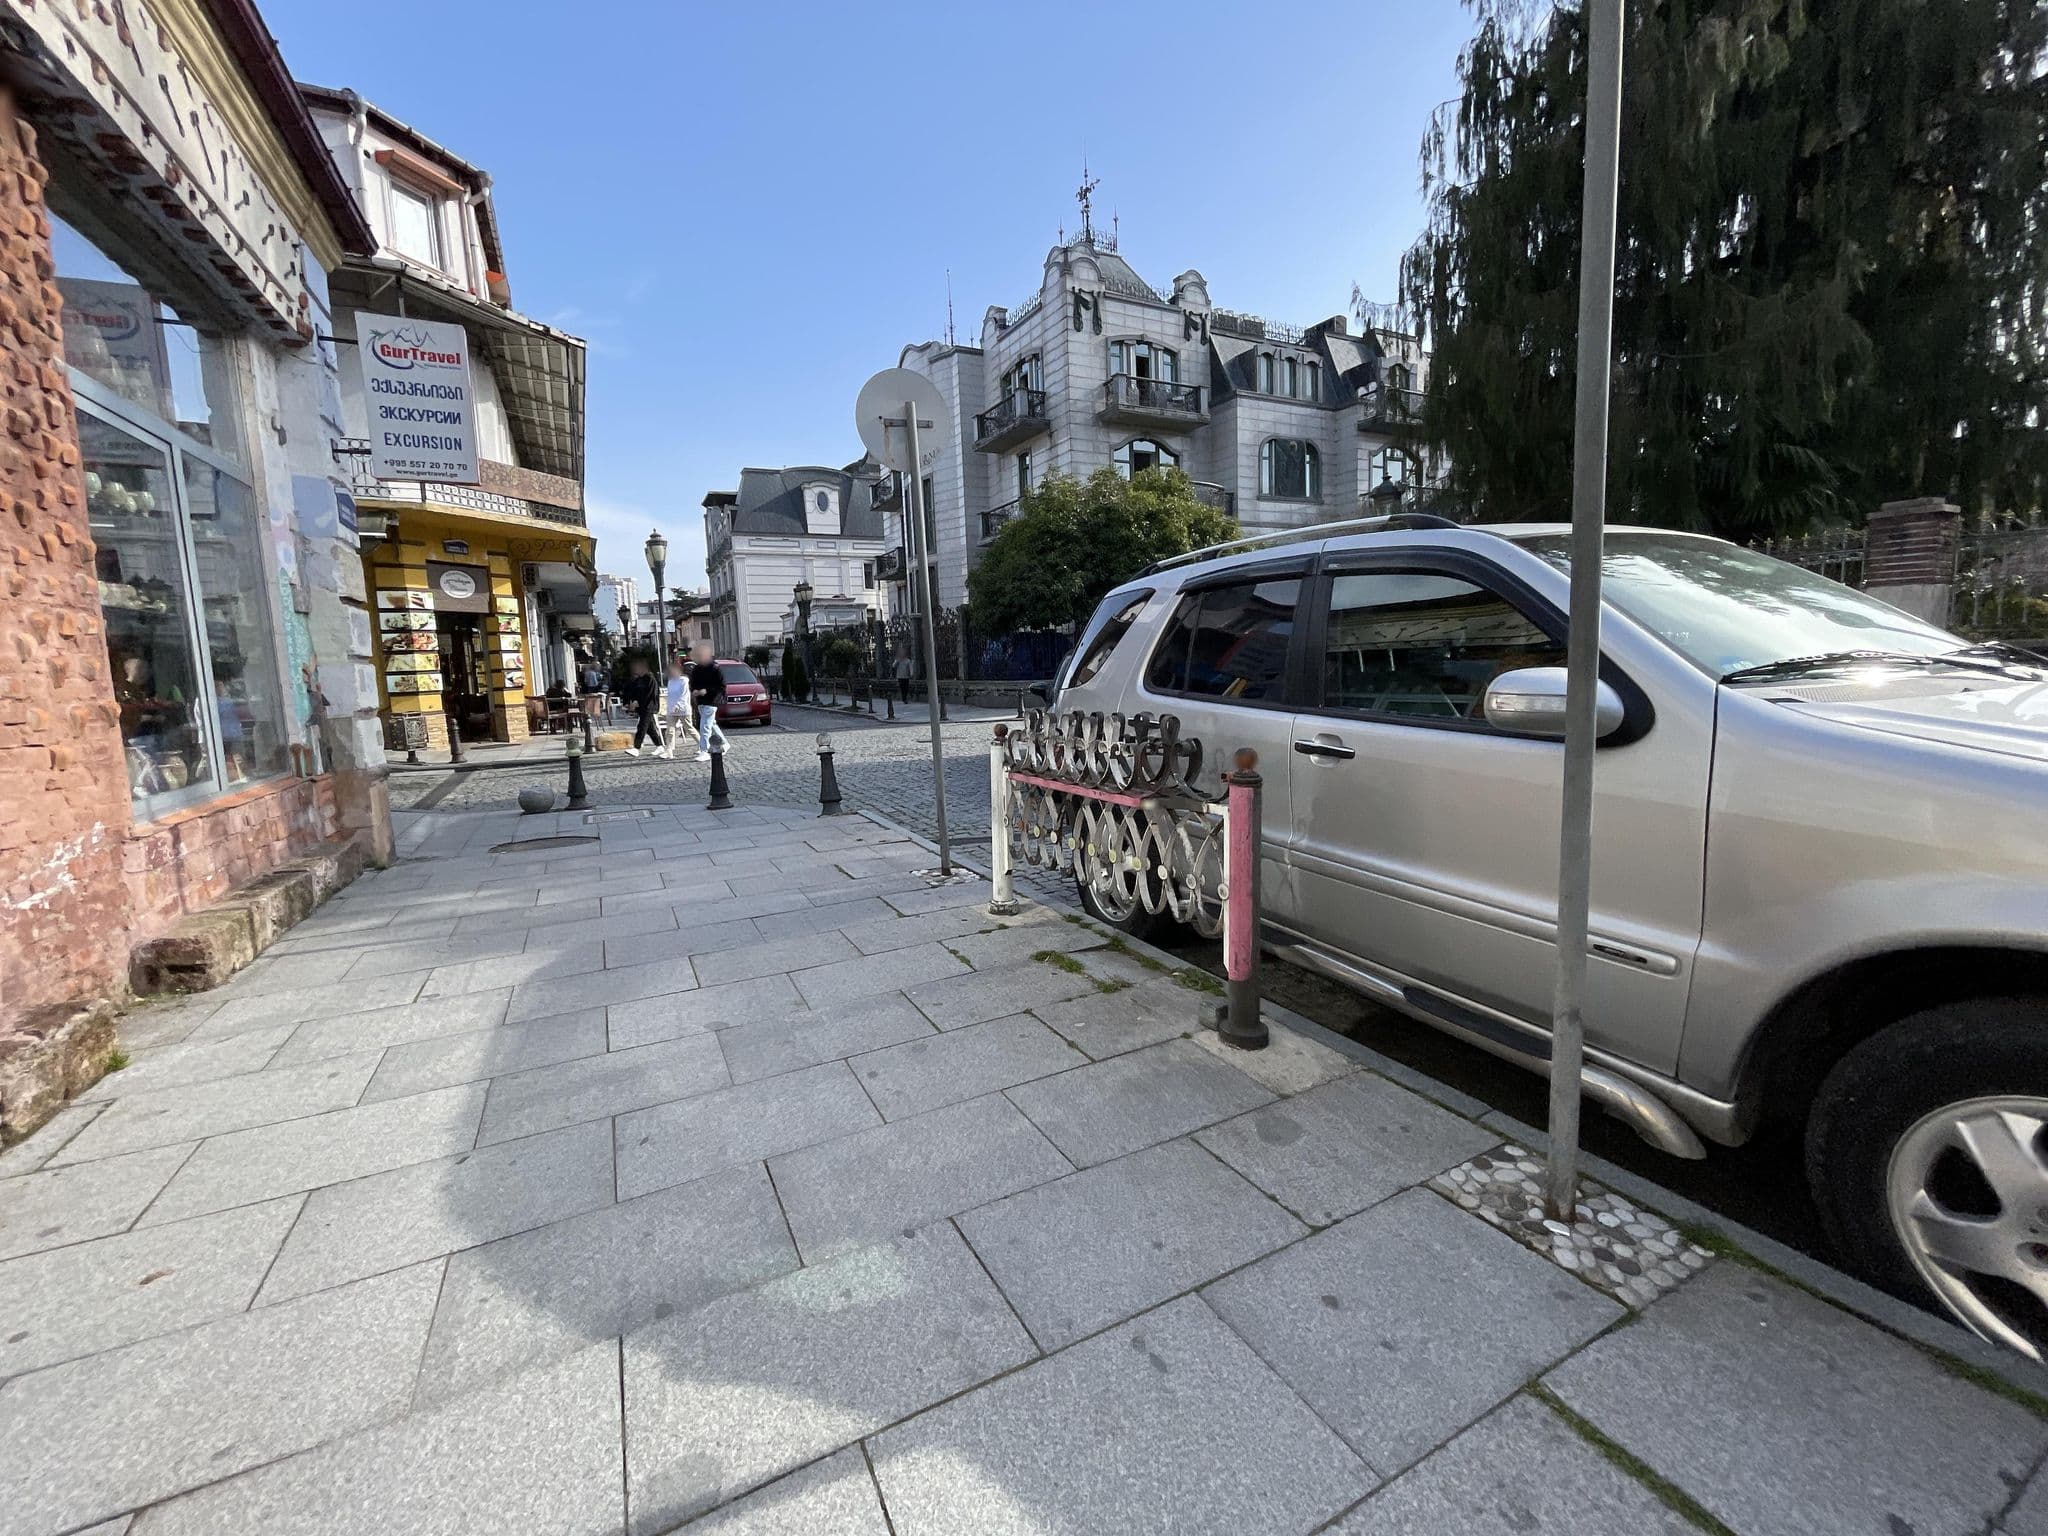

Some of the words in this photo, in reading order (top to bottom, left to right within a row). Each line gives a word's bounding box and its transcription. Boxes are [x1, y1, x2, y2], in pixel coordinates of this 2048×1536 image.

[380, 343, 460, 365] GurTravel
[379, 405, 461, 425] ЭКСКУРСИИ
[384, 432, 462, 451] EXCURSION
[384, 459, 406, 467] +995
[409, 460, 425, 468] 557
[429, 461, 440, 469] 20
[443, 462, 454, 470] 70
[457, 463, 468, 471] 70
